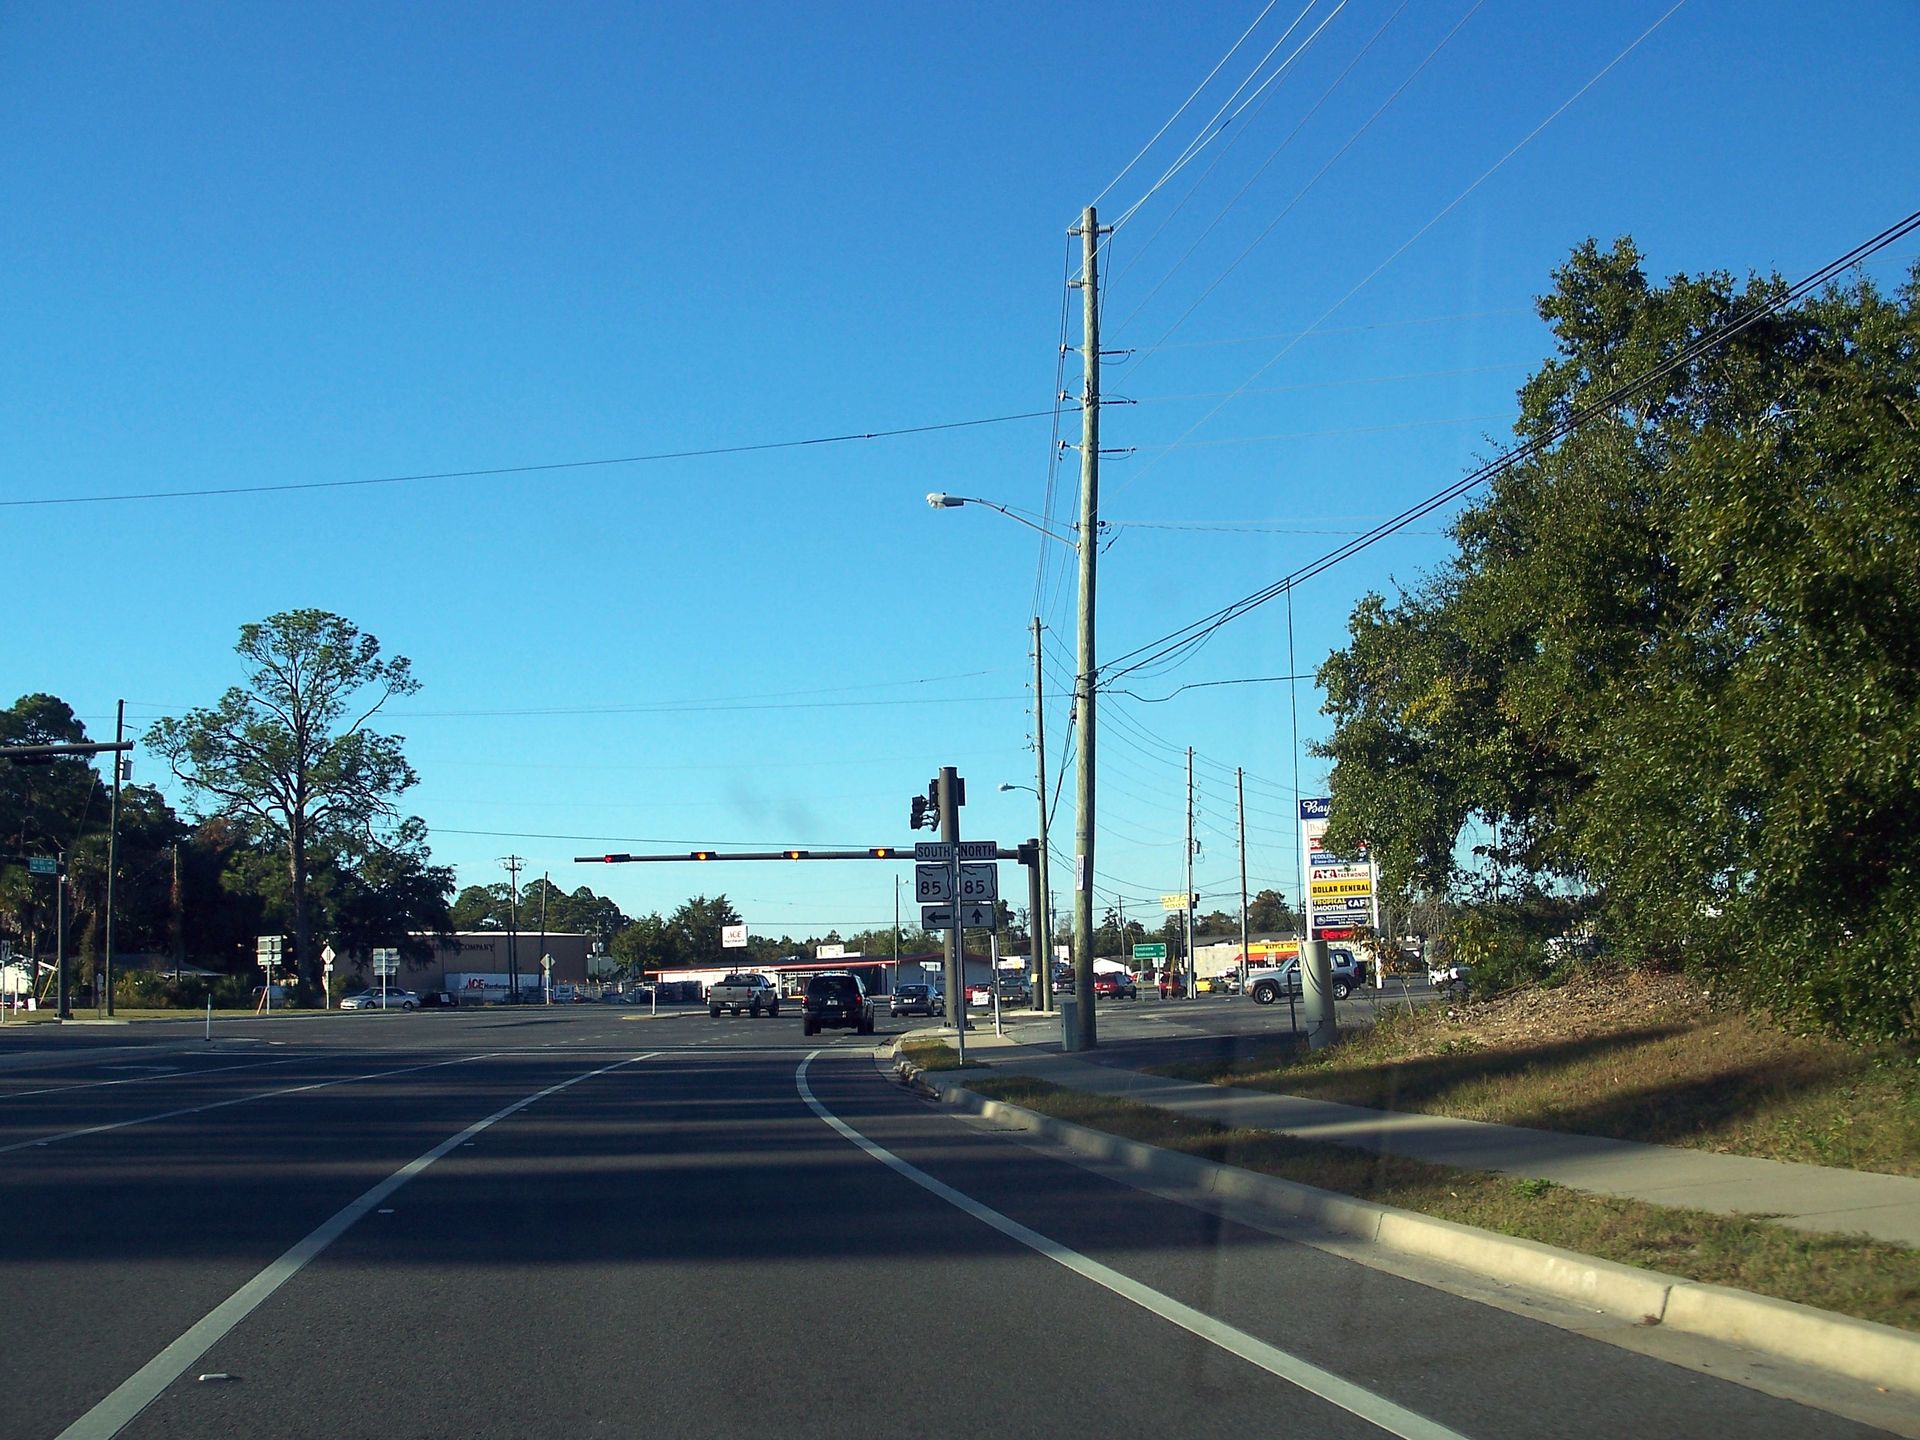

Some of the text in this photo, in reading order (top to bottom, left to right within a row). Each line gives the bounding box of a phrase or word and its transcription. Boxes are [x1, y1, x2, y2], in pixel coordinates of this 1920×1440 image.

[917, 846, 950, 858] SOUTH
[960, 845, 994, 857] NORTH
[921, 881, 940, 895] 85
[965, 880, 984, 894] 85
[1312, 883, 1369, 894] DOLLAR GENERAL
[1312, 904, 1347, 912] SMOOTHIE
[727, 930, 742, 939] ACE
[466, 977, 485, 990] ACE
